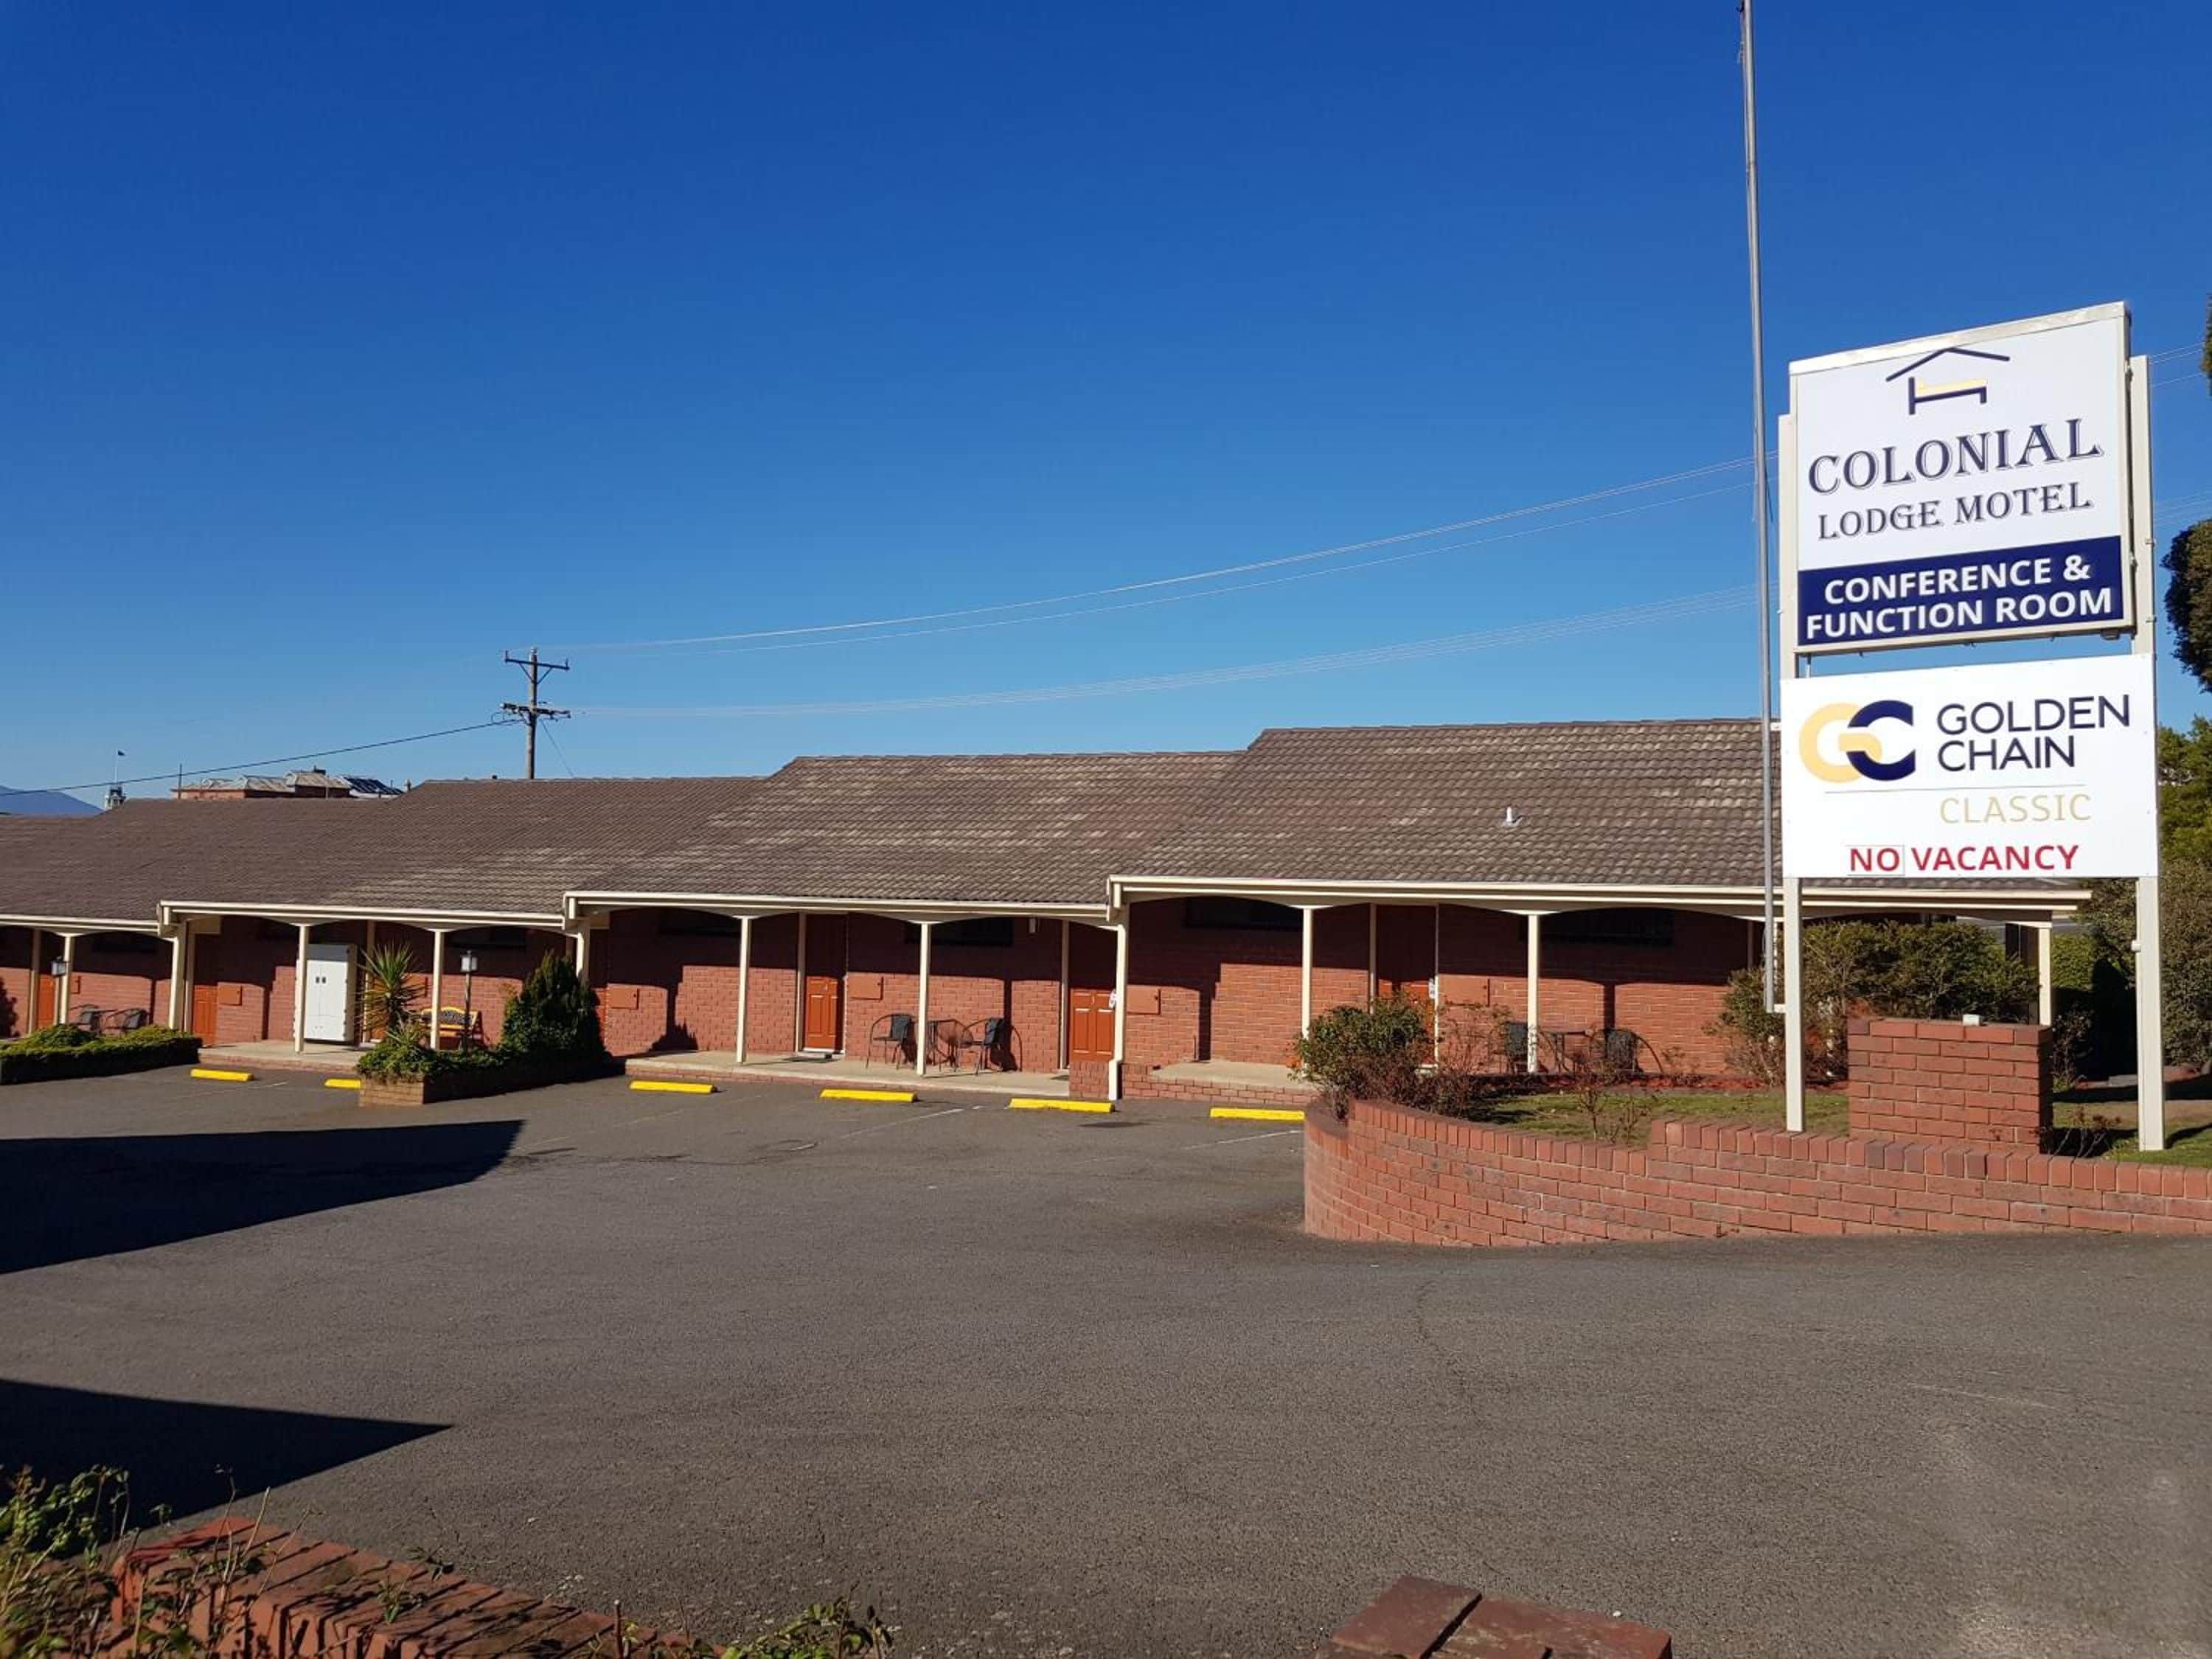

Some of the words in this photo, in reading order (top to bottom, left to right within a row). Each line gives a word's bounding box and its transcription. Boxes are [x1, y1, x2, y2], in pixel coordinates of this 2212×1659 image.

[1809, 418, 2103, 494] COLONIAL
[1818, 500, 1943, 540] LODGE
[1955, 481, 2093, 524] MOTEL
[1824, 557, 2052, 605] CONFERENCE
[2063, 554, 2091, 581] &
[1806, 599, 1983, 640] FUNCTION
[1995, 588, 2112, 623] ROOM
[1936, 695, 2130, 735] GOLDEN
[1937, 734, 2076, 772] CHAIN
[1940, 794, 2092, 824] CLASSIC
[1849, 847, 1900, 872] NO
[1911, 844, 2079, 872] VACANCY
